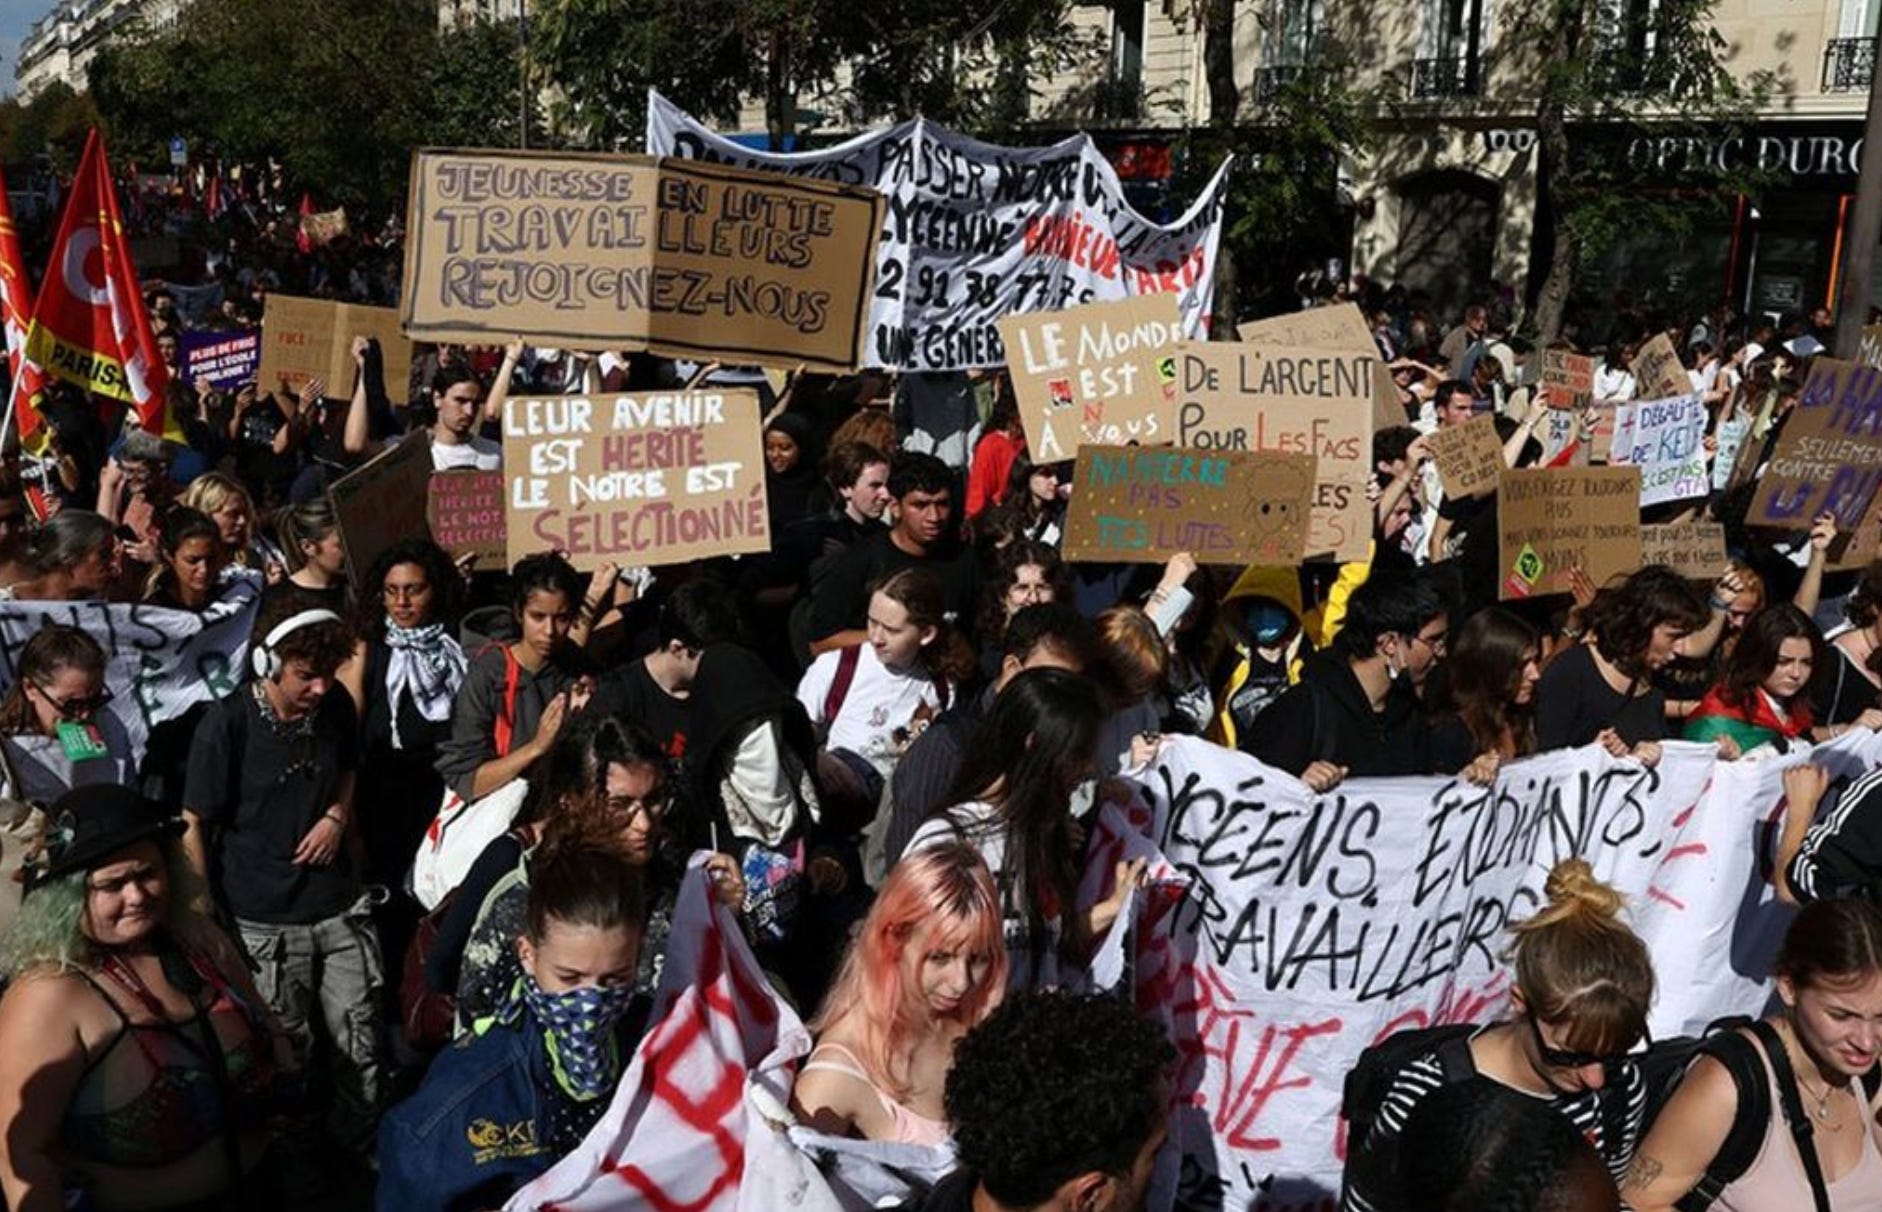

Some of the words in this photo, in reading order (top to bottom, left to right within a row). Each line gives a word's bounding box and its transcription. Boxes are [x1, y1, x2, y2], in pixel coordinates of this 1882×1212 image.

[875, 138, 984, 208] PASSER
[998, 153, 1080, 202] NOTRE
[436, 161, 632, 201] JEUNESSE
[660, 176, 705, 214] EN
[723, 186, 834, 237] LUTTE
[880, 192, 1015, 257] YCÉENNE
[441, 257, 832, 334] REJOIGNEZ-NOUS
[914, 265, 950, 308] 91
[876, 323, 919, 369] UNE
[923, 316, 1005, 369] GÉNÉR
[1019, 322, 1069, 375] LE
[1080, 362, 1138, 400] EST
[1239, 352, 1374, 399] L'ARGENT
[505, 399, 592, 437] LEUR
[612, 391, 725, 430] AVENIR
[1038, 407, 1064, 459] À
[530, 439, 583, 476] EST
[1772, 459, 1836, 482] CONTRE
[512, 476, 550, 509] LE
[569, 469, 666, 505] NOTRE
[686, 461, 743, 495] EST
[1129, 484, 1182, 509] PAS
[467, 511, 503, 526] NOT
[532, 482, 766, 555] SÉLECTIONNÉ
[1096, 515, 1147, 549] TES
